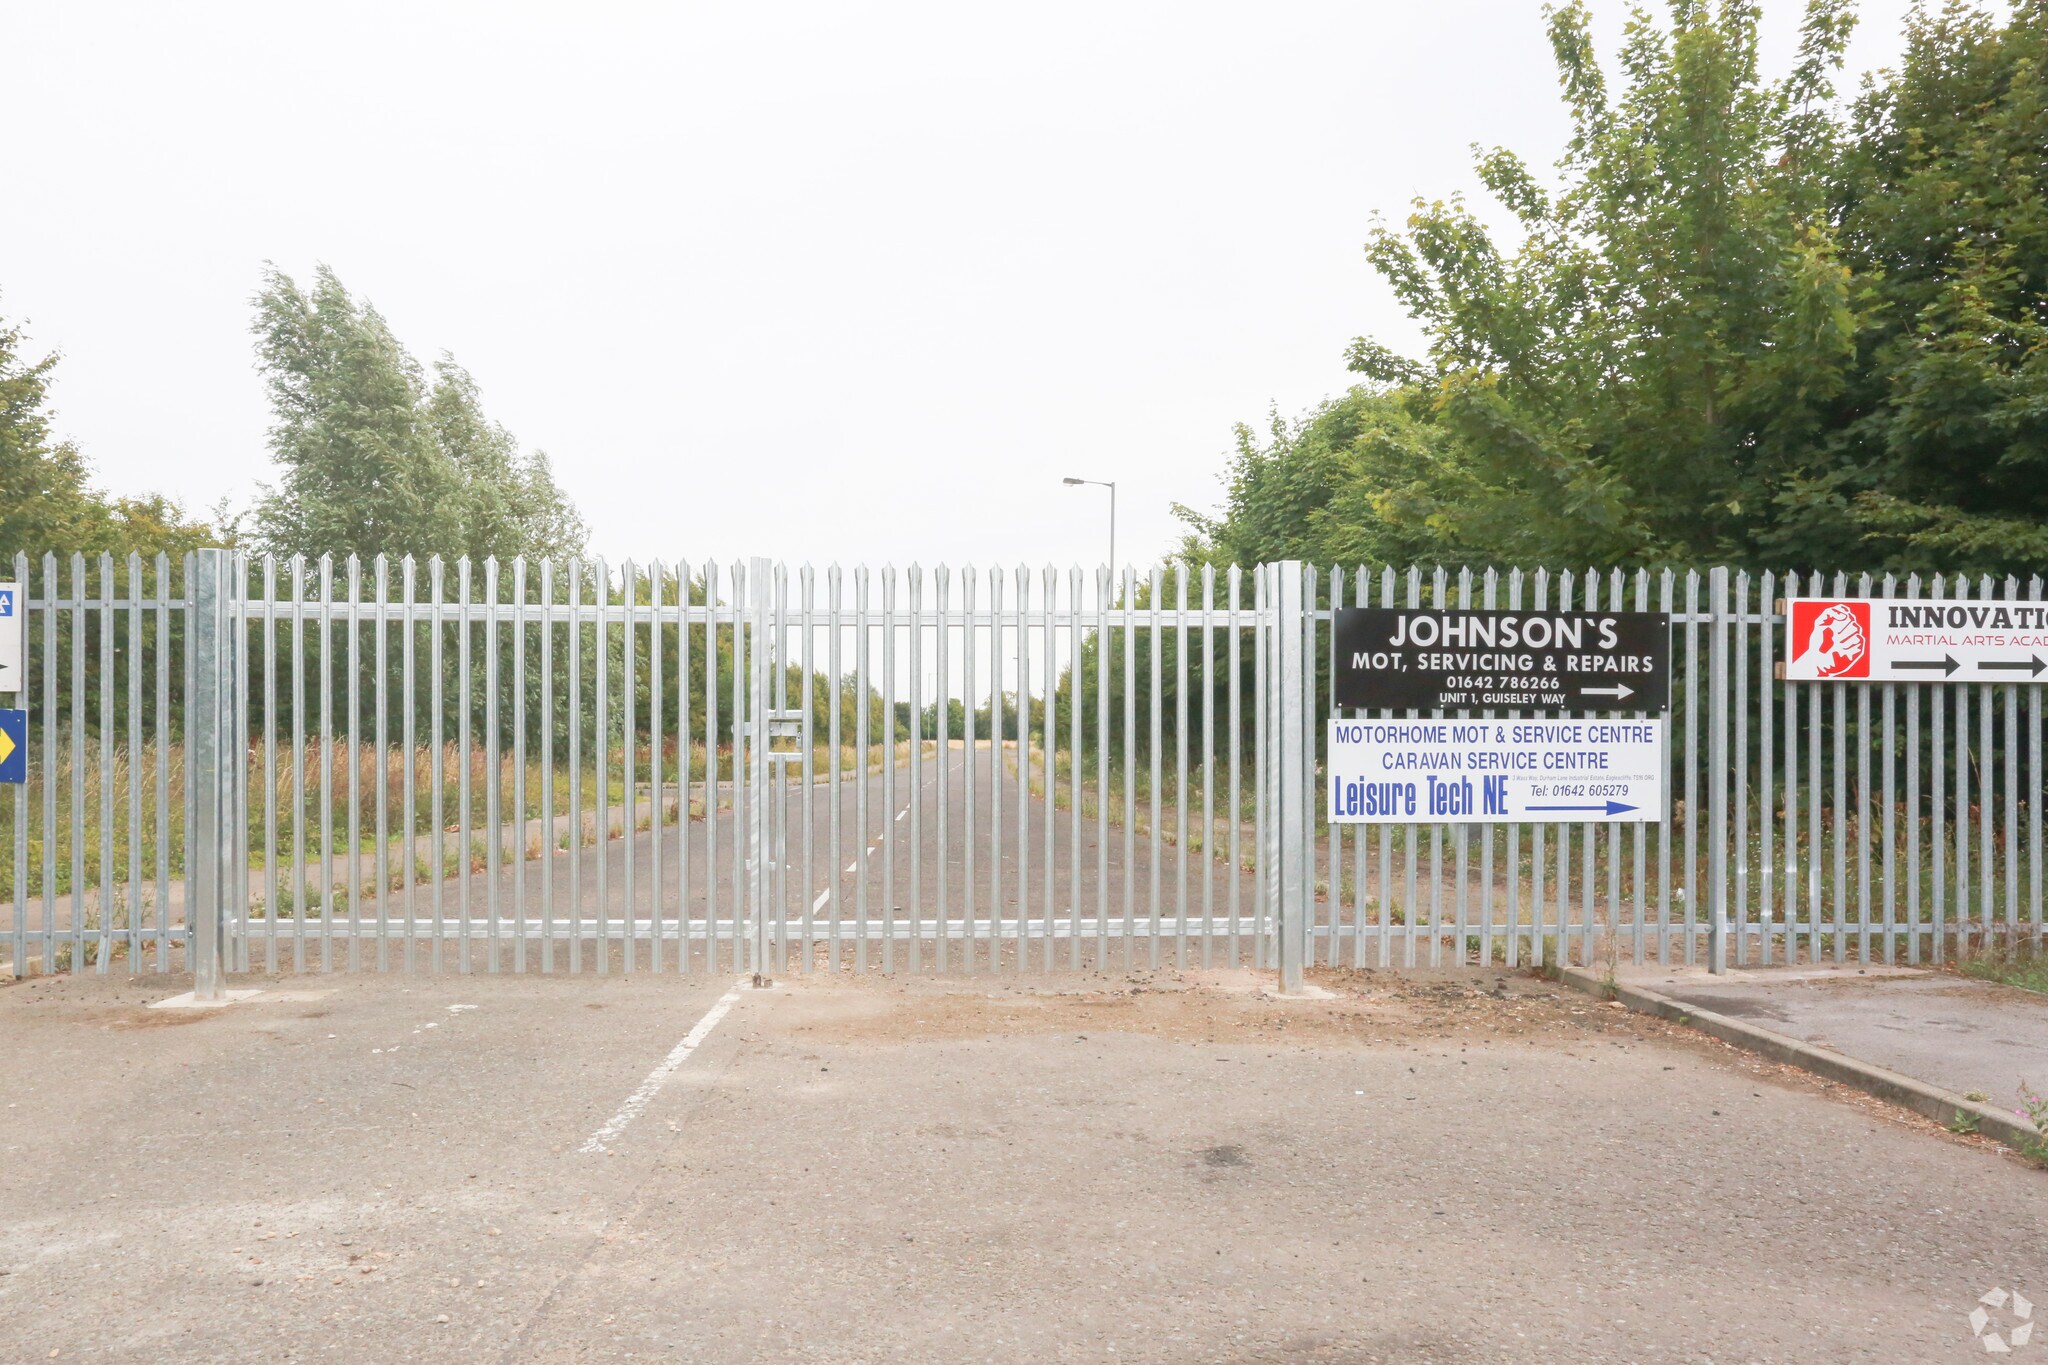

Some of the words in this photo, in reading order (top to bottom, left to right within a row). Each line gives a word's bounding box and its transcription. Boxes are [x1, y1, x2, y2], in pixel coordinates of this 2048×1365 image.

[1888, 606, 2048, 629] INNOVATI
[1887, 635, 1957, 646] MARTIAL
[1962, 636, 2004, 646] ARTS
[1352, 652, 1408, 673] MOT,
[1418, 653, 1533, 671] SERVICING
[1543, 656, 1557, 671] &
[1567, 655, 1653, 673] REPAIRS
[1447, 676, 1492, 689] 01642
[1500, 677, 1560, 690] 786266
[1440, 693, 1467, 703] UNIT
[1471, 693, 1478, 705] 1,
[1483, 693, 1537, 704] GUISELEY
[1541, 694, 1566, 704] WAY
[1336, 726, 1446, 743] MOTORHOME
[1453, 726, 1489, 743] MOT
[1495, 726, 1506, 743] &
[1512, 726, 1581, 743] SERVICE
[1588, 726, 1653, 743] CENTRE
[1382, 752, 1461, 770] CARAVAN
[1468, 752, 1537, 770] SERVICE
[1544, 752, 1608, 769] CENTRE
[1335, 775, 1416, 816] Leisure
[1427, 775, 1472, 815] Tech
[1484, 775, 1508, 814] NE
[1531, 785, 1548, 796] Tel:
[1553, 785, 1584, 796] 01642
[1589, 785, 1629, 796] 605279
